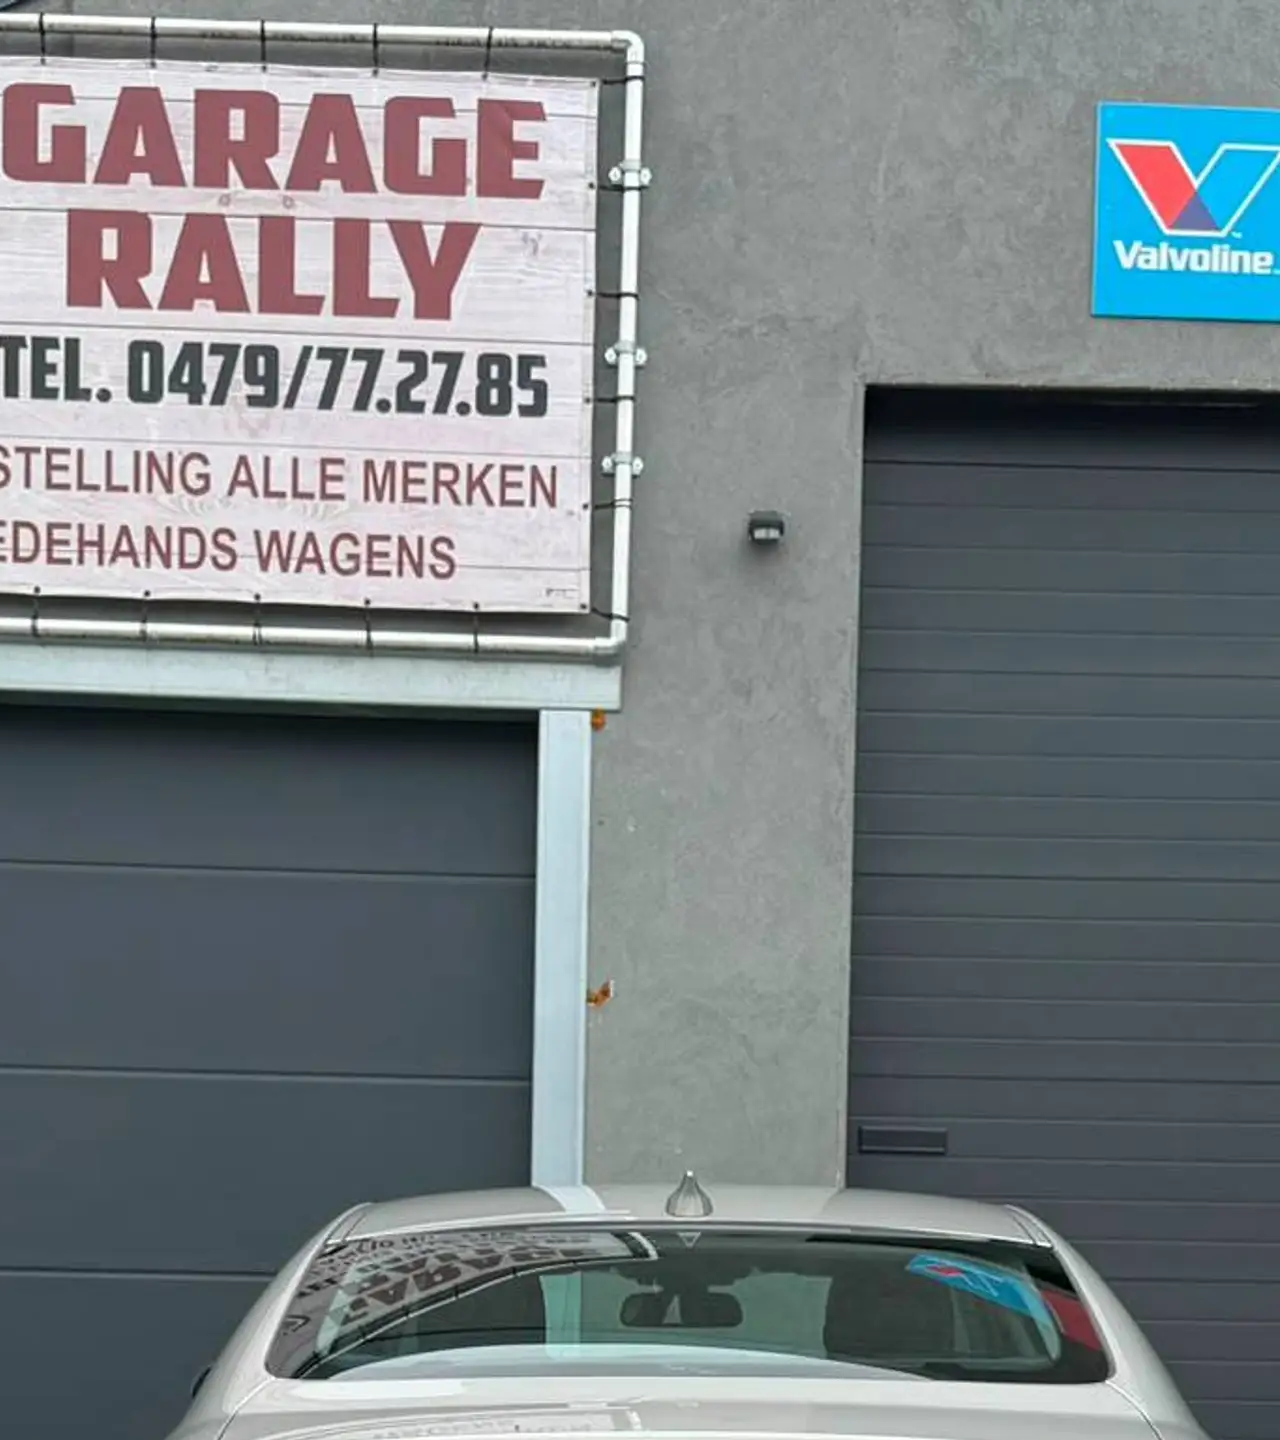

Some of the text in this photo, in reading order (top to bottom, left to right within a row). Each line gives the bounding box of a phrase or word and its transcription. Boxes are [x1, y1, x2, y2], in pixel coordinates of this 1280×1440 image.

[1, 82, 547, 200] GARAGE
[66, 208, 482, 320] RALLY
[1112, 239, 1274, 275] Valvoline
[127, 339, 548, 417] 0479/77.27.85
[227, 454, 346, 500] ALLE
[363, 459, 558, 508] MERKEN
[255, 529, 456, 580] WAGENS
